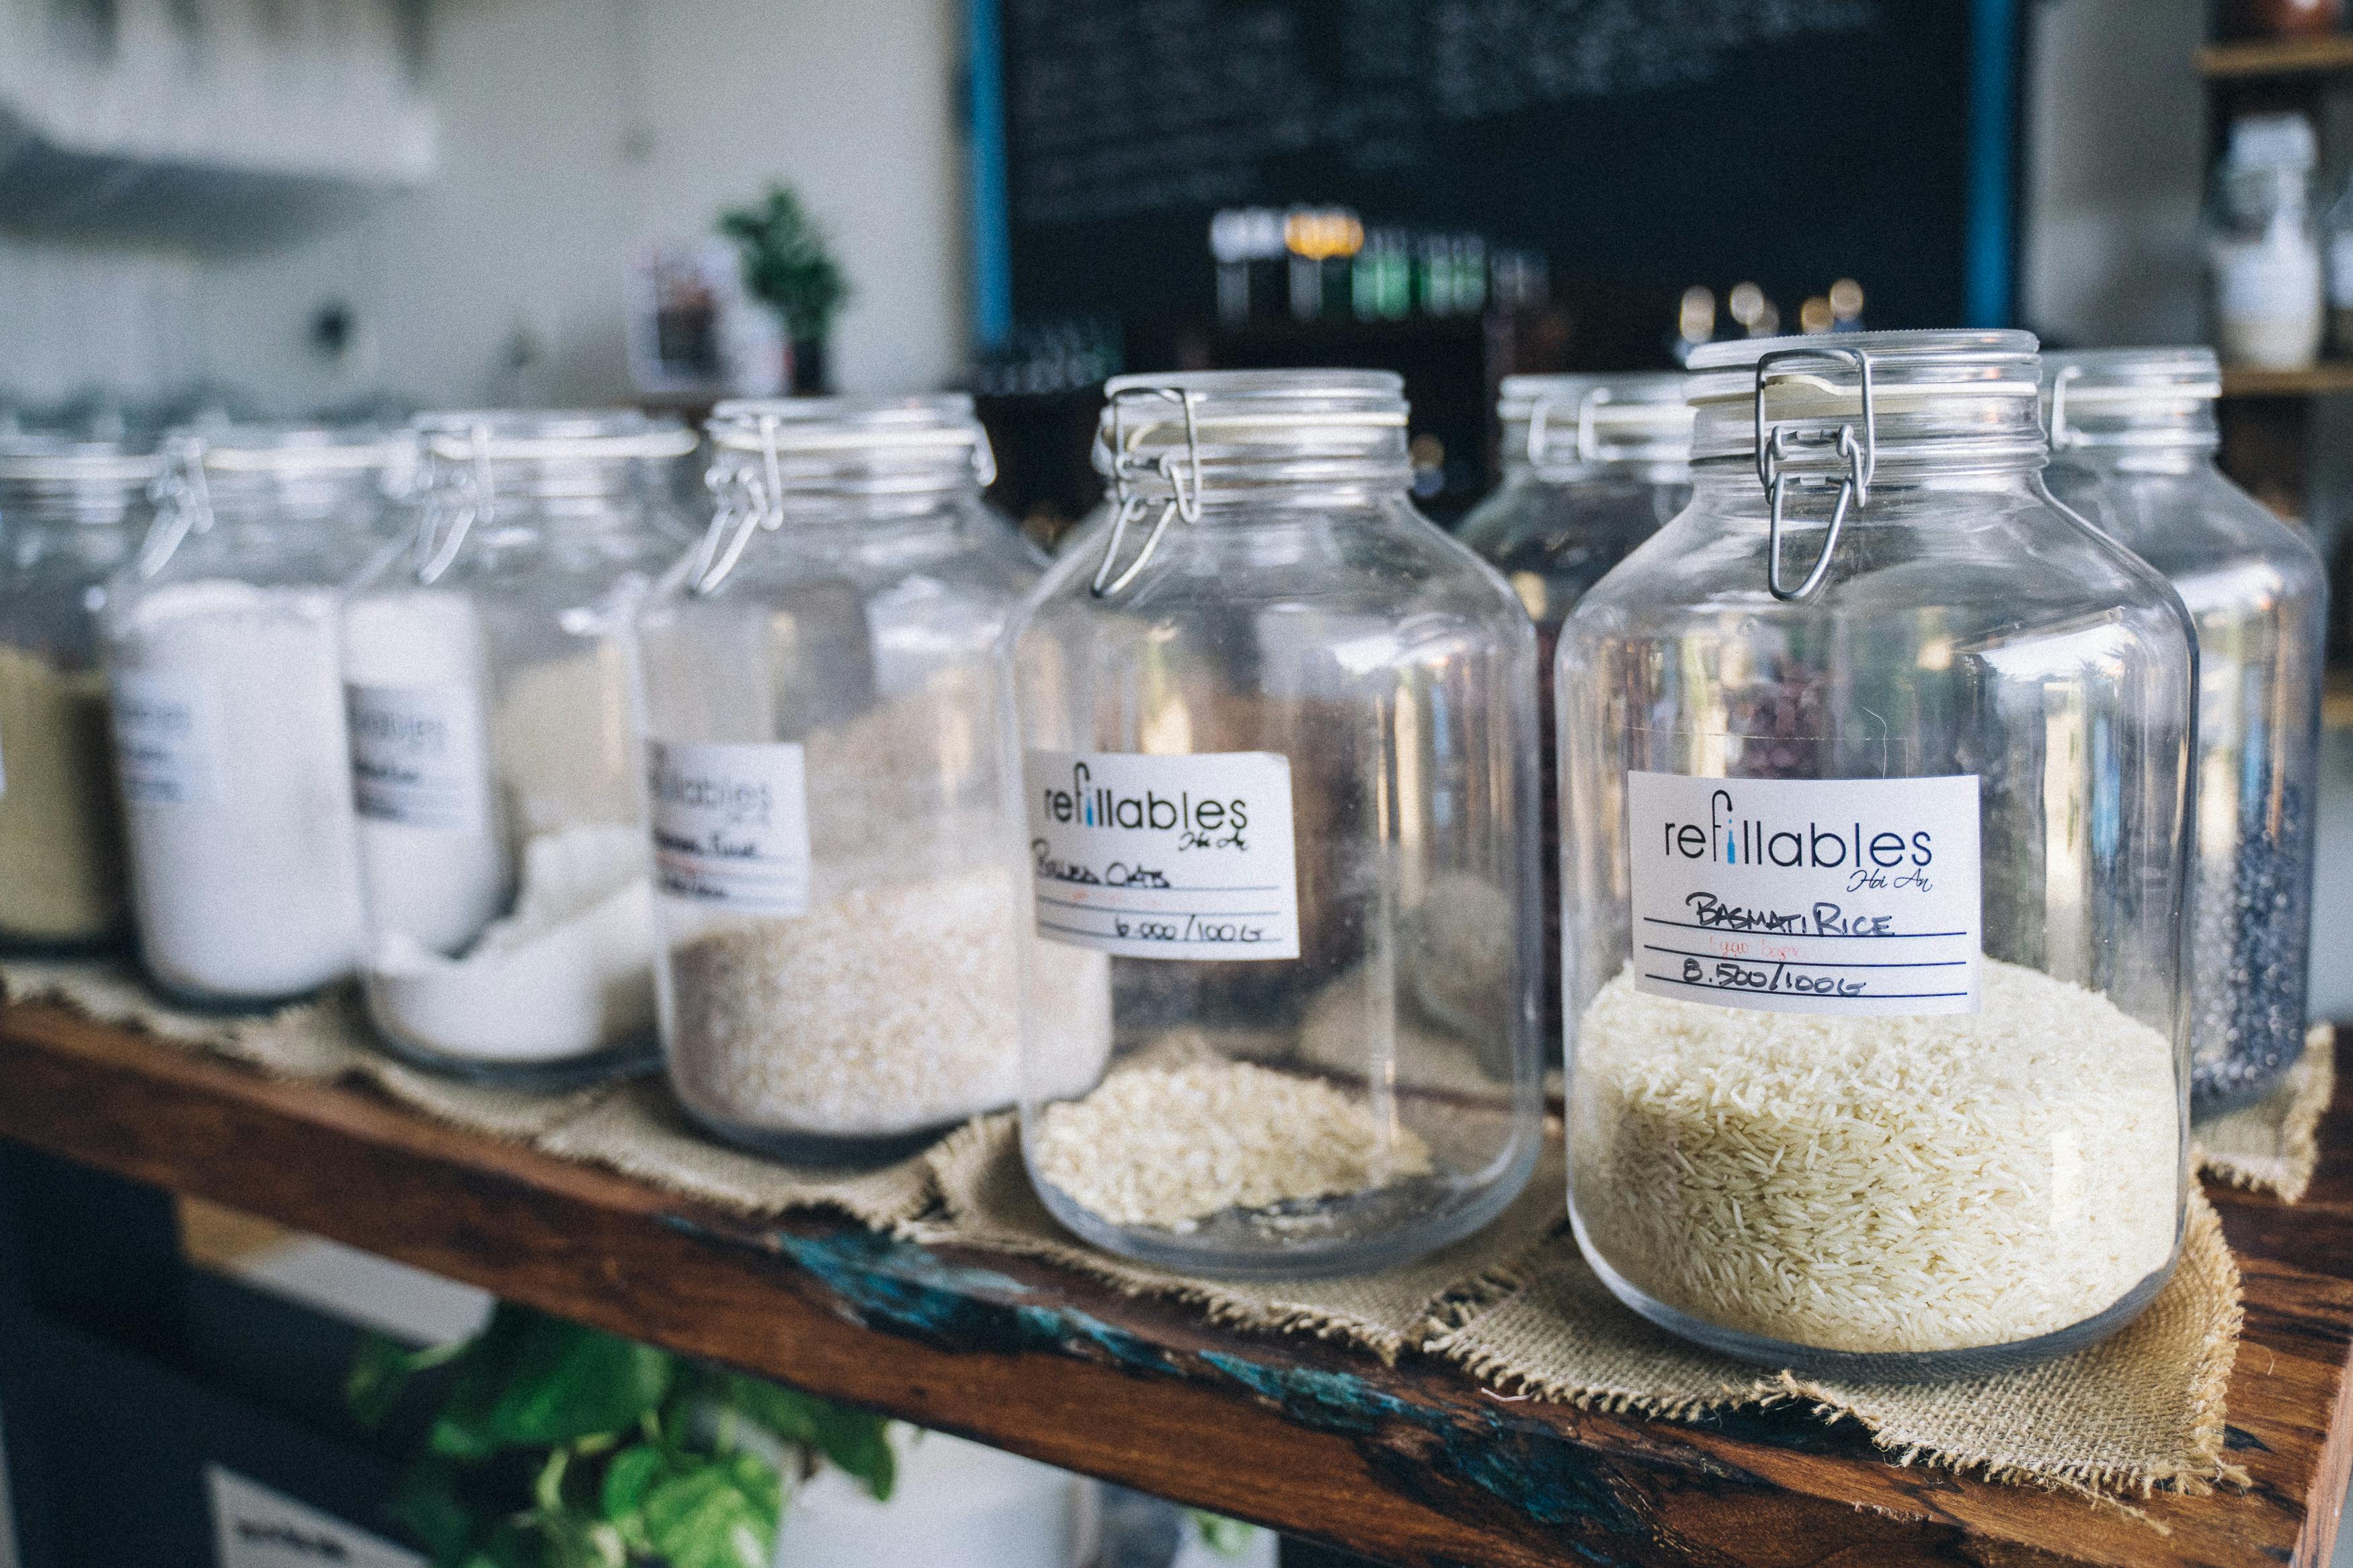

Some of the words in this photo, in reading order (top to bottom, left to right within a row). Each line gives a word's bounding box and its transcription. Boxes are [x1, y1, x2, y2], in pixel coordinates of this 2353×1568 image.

[1044, 761, 1248, 829] refillables
[1665, 789, 1932, 867] refillables
[1847, 868, 1888, 893] Hoi
[1894, 868, 1933, 893] An
[1685, 892, 1807, 934] BASMATI
[1812, 902, 1895, 937] RICE
[1683, 958, 1867, 997] 8.500/100G
